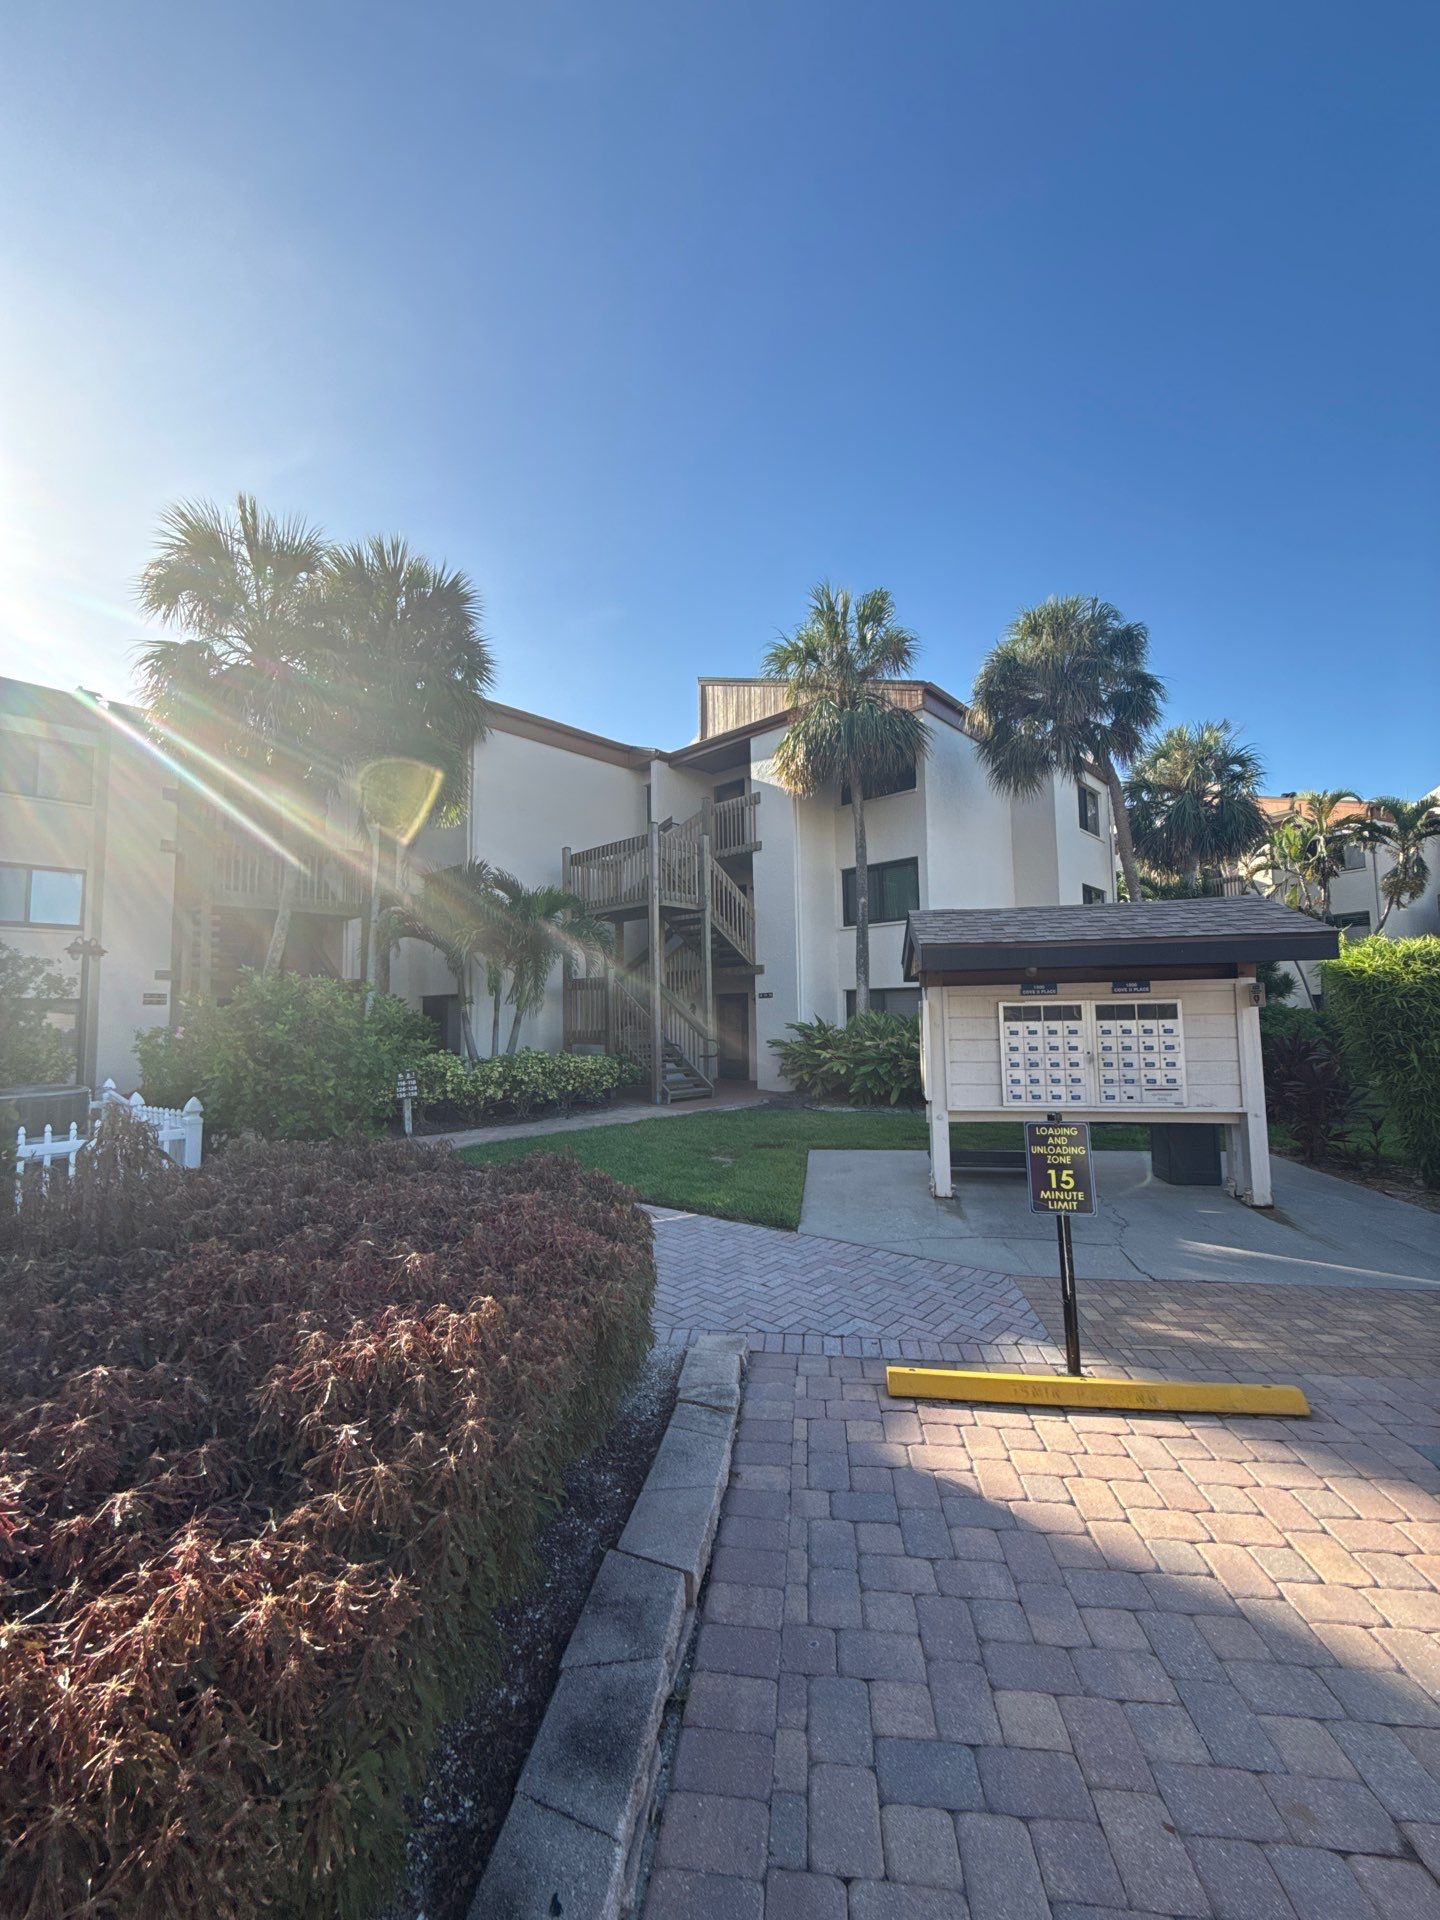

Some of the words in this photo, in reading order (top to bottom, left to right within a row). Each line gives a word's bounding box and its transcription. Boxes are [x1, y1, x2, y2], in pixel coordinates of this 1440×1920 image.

[1035, 1127, 1078, 1136] LOADING
[1047, 1137, 1068, 1145] AND
[1031, 1146, 1086, 1155] UNLOADING
[1047, 1156, 1072, 1164] ZONE
[1047, 1169, 1075, 1189] 15
[1040, 1190, 1085, 1200] MINUTE
[1048, 1201, 1078, 1210] LIMIT
